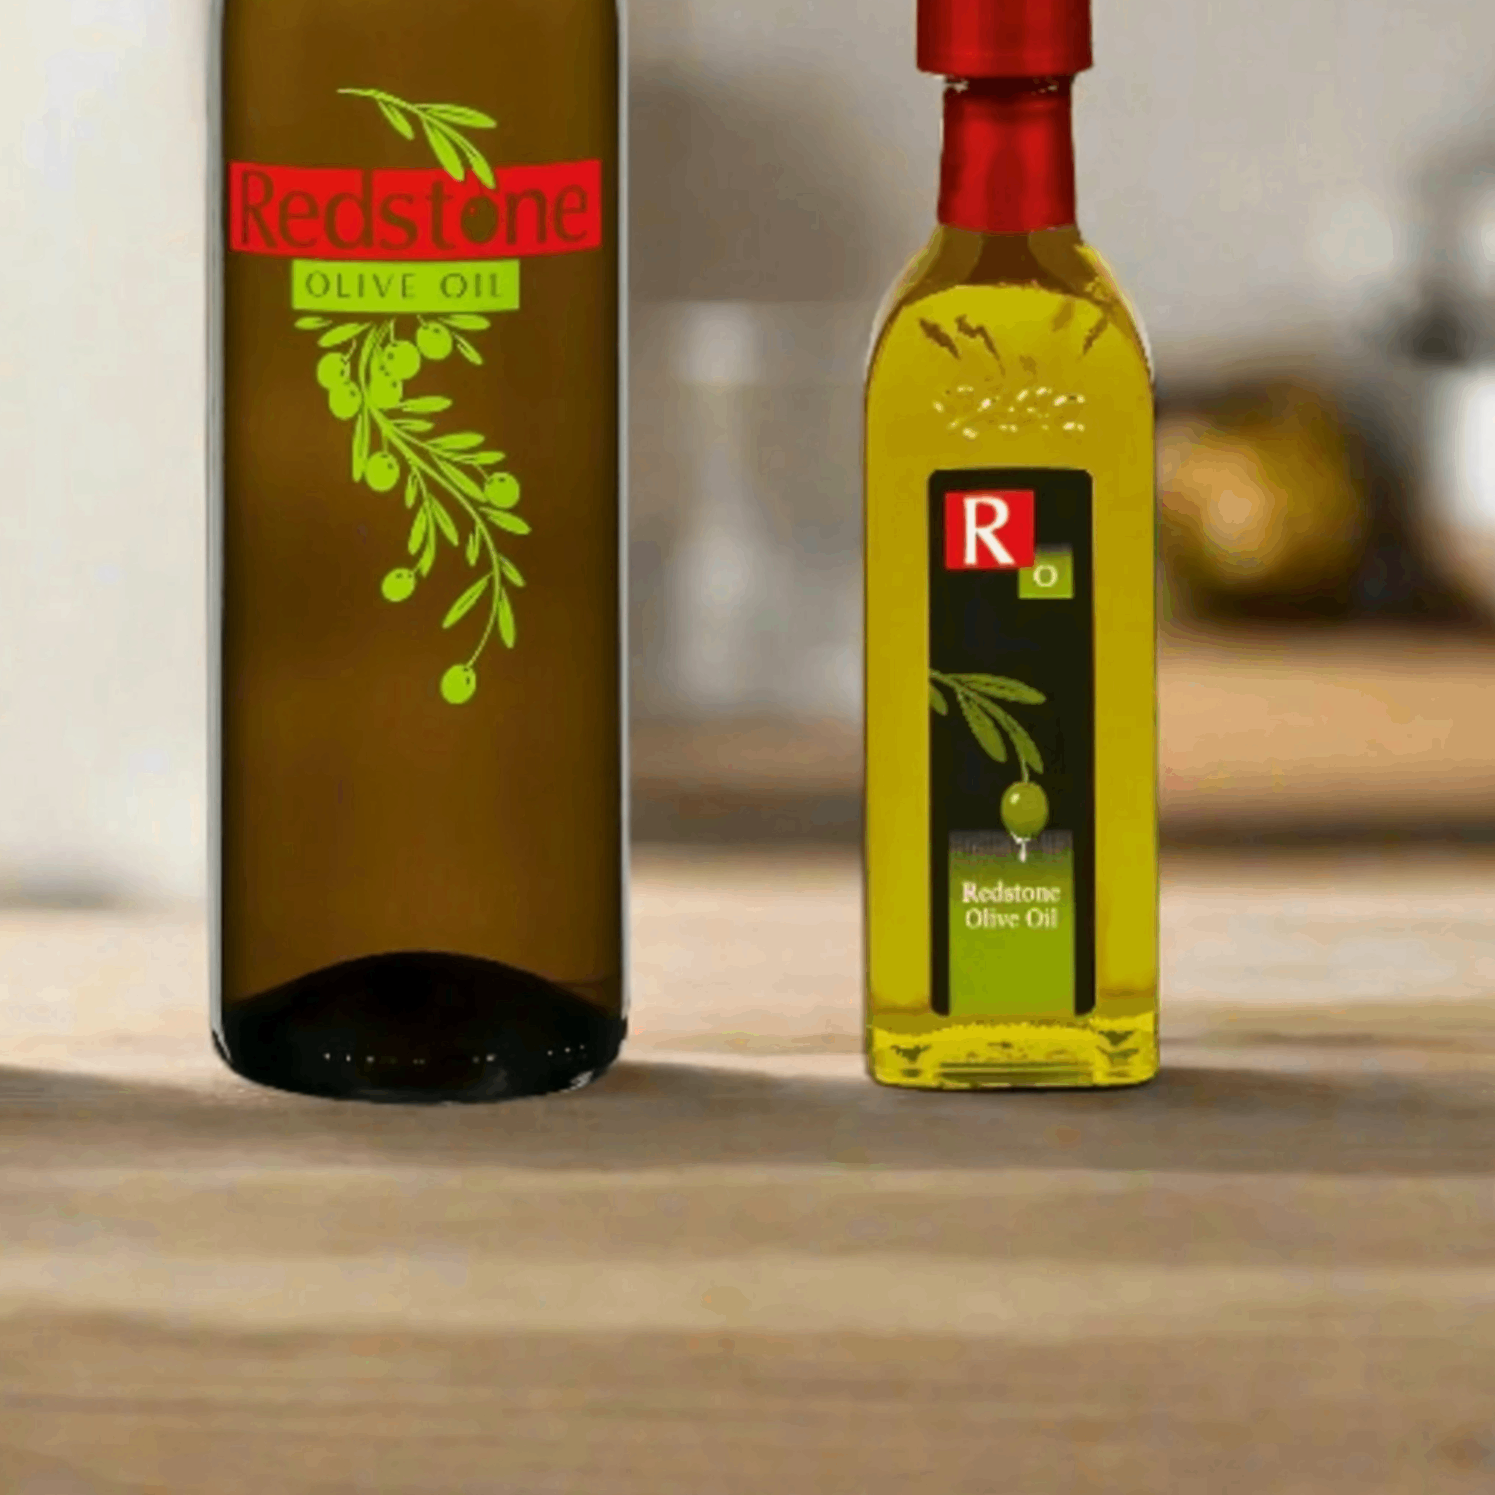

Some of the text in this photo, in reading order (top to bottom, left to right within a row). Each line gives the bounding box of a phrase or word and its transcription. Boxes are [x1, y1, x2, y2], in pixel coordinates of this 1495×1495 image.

[242, 169, 588, 251] Redstone
[305, 271, 503, 299] OLIVE OIL
[964, 496, 1015, 565] R
[962, 879, 1061, 903] Redstone
[965, 907, 1058, 929] Olive Oil
